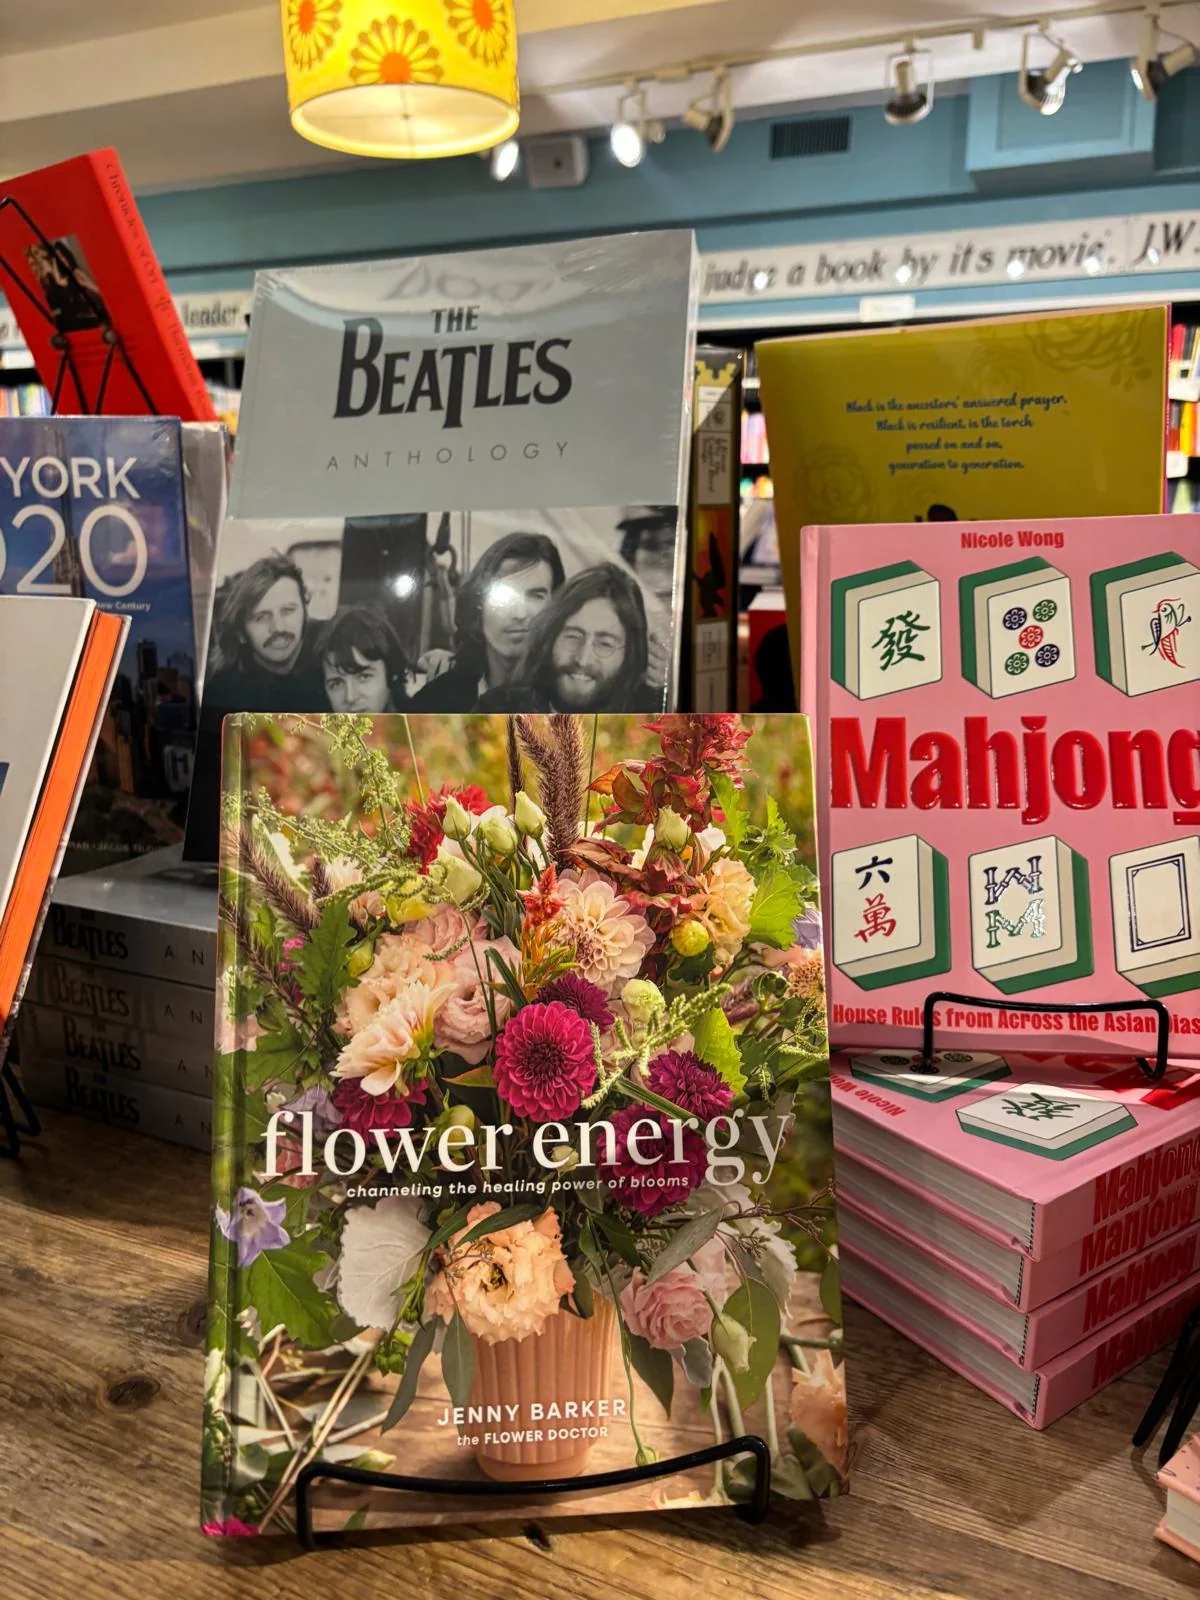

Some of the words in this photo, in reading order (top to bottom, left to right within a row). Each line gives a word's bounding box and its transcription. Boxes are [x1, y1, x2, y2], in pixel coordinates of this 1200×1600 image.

[787, 264, 806, 287] a
[815, 252, 885, 284] book
[900, 244, 939, 287] by
[432, 305, 480, 334] THE
[333, 317, 573, 429] BEATLES
[847, 398, 873, 413] Black
[876, 402, 886, 411] is
[888, 398, 902, 410] the
[963, 392, 1018, 408] answered
[1020, 394, 1068, 411] prayer.
[877, 418, 905, 432] Black
[908, 421, 918, 431] is
[968, 418, 979, 428] is
[981, 415, 999, 428] the
[1001, 414, 1033, 429] torch
[326, 441, 569, 472] ANTHOLOGY
[906, 436, 942, 454] passed
[944, 442, 958, 450] on
[962, 436, 983, 449] and
[0, 457, 141, 499] YORK
[889, 459, 946, 475] generation
[947, 459, 959, 469] to
[961, 459, 1025, 475] generation.
[0, 504, 148, 597] 20
[961, 532, 1013, 550] Nicole
[1018, 531, 1064, 549] Wong
[115, 601, 151, 612] Century
[872, 610, 931, 671] 發
[833, 1004, 887, 1025] House
[946, 1003, 993, 1029] from
[998, 1004, 1063, 1030] Across
[1068, 1010, 1099, 1031] the
[1104, 1012, 1156, 1033] Asian
[1168, 1013, 1200, 1034] ias
[854, 1089, 906, 1117] Nicole
[260, 1110, 513, 1177] flower
[533, 1107, 792, 1186] energy
[346, 1182, 443, 1198] channeling
[448, 1182, 477, 1194] the
[483, 1179, 546, 1194] healing
[551, 1179, 602, 1194] power
[608, 1176, 626, 1189] of
[630, 1175, 689, 1189] blooms
[437, 1404, 520, 1426] JENNY
[530, 1399, 626, 1421] BARKER
[456, 1435, 480, 1447] the
[484, 1429, 543, 1445] FLOWER
[548, 1426, 609, 1441] DOCTOR
